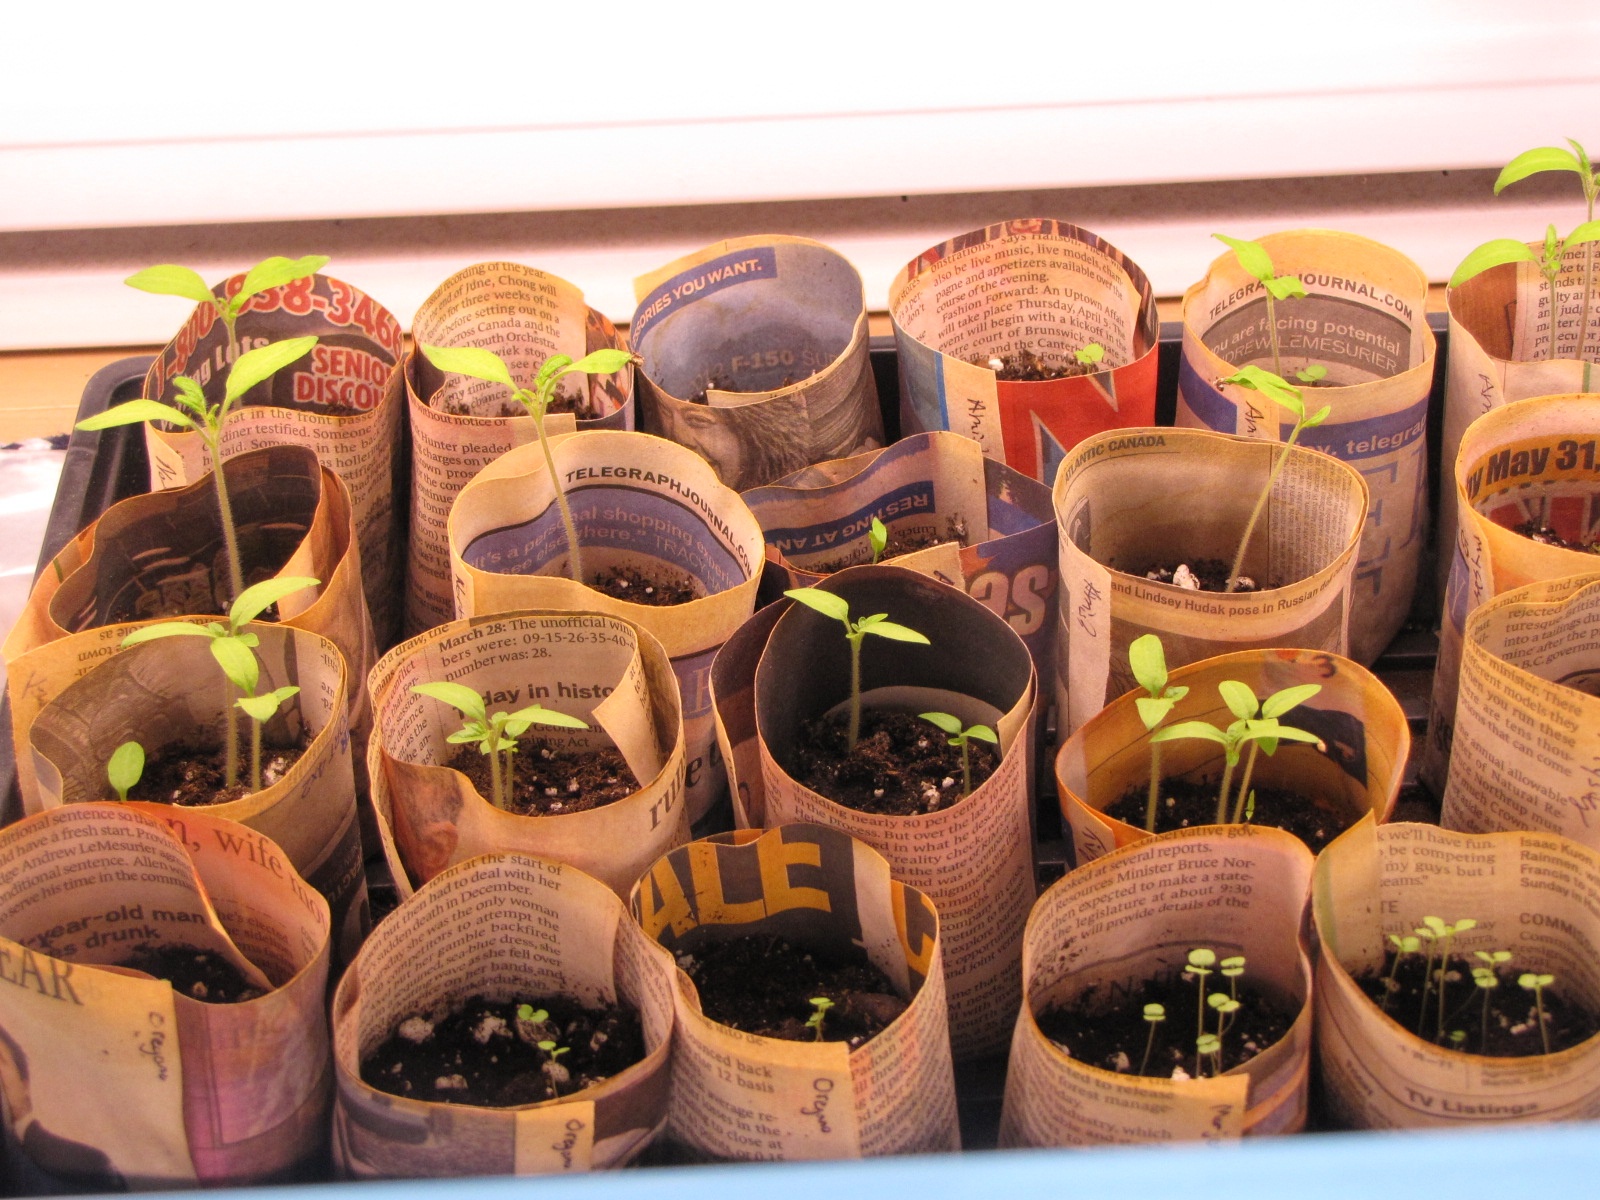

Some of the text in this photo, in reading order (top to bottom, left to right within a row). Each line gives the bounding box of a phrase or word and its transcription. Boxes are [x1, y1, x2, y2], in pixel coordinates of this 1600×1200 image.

[995, 245, 1100, 269] music, live models,
[503, 263, 546, 279] the year.
[672, 258, 762, 299] YOU WANT.
[935, 258, 1095, 300] pagne and appetizers available
[466, 276, 557, 296] June, Chong will
[936, 272, 1049, 314] course the evening.
[462, 290, 530, 308] three weeks
[943, 285, 1102, 323] Fashion Forward: Uptown
[445, 304, 537, 334] before setting out
[984, 300, 1100, 324] place Thursday, April
[477, 318, 560, 338] Canada and the
[973, 326, 1085, 347] court Brunswick
[992, 312, 1103, 337] begin with kickoff
[472, 333, 558, 350] Youth Orchestra.
[1324, 319, 1400, 356] potential
[731, 351, 795, 372] F-150
[422, 433, 512, 453] Hunter pleaded
[1108, 436, 1165, 451] CANADA
[1486, 448, 1550, 485] May
[1111, 581, 1318, 617] and Lindsey Hudak pose Russian
[439, 617, 605, 653] March 28: The unofficial
[441, 648, 471, 667] bers
[476, 636, 516, 654] were:
[445, 648, 551, 682] number was: 28.
[528, 684, 549, 698] in
[568, 735, 589, 746] Act
